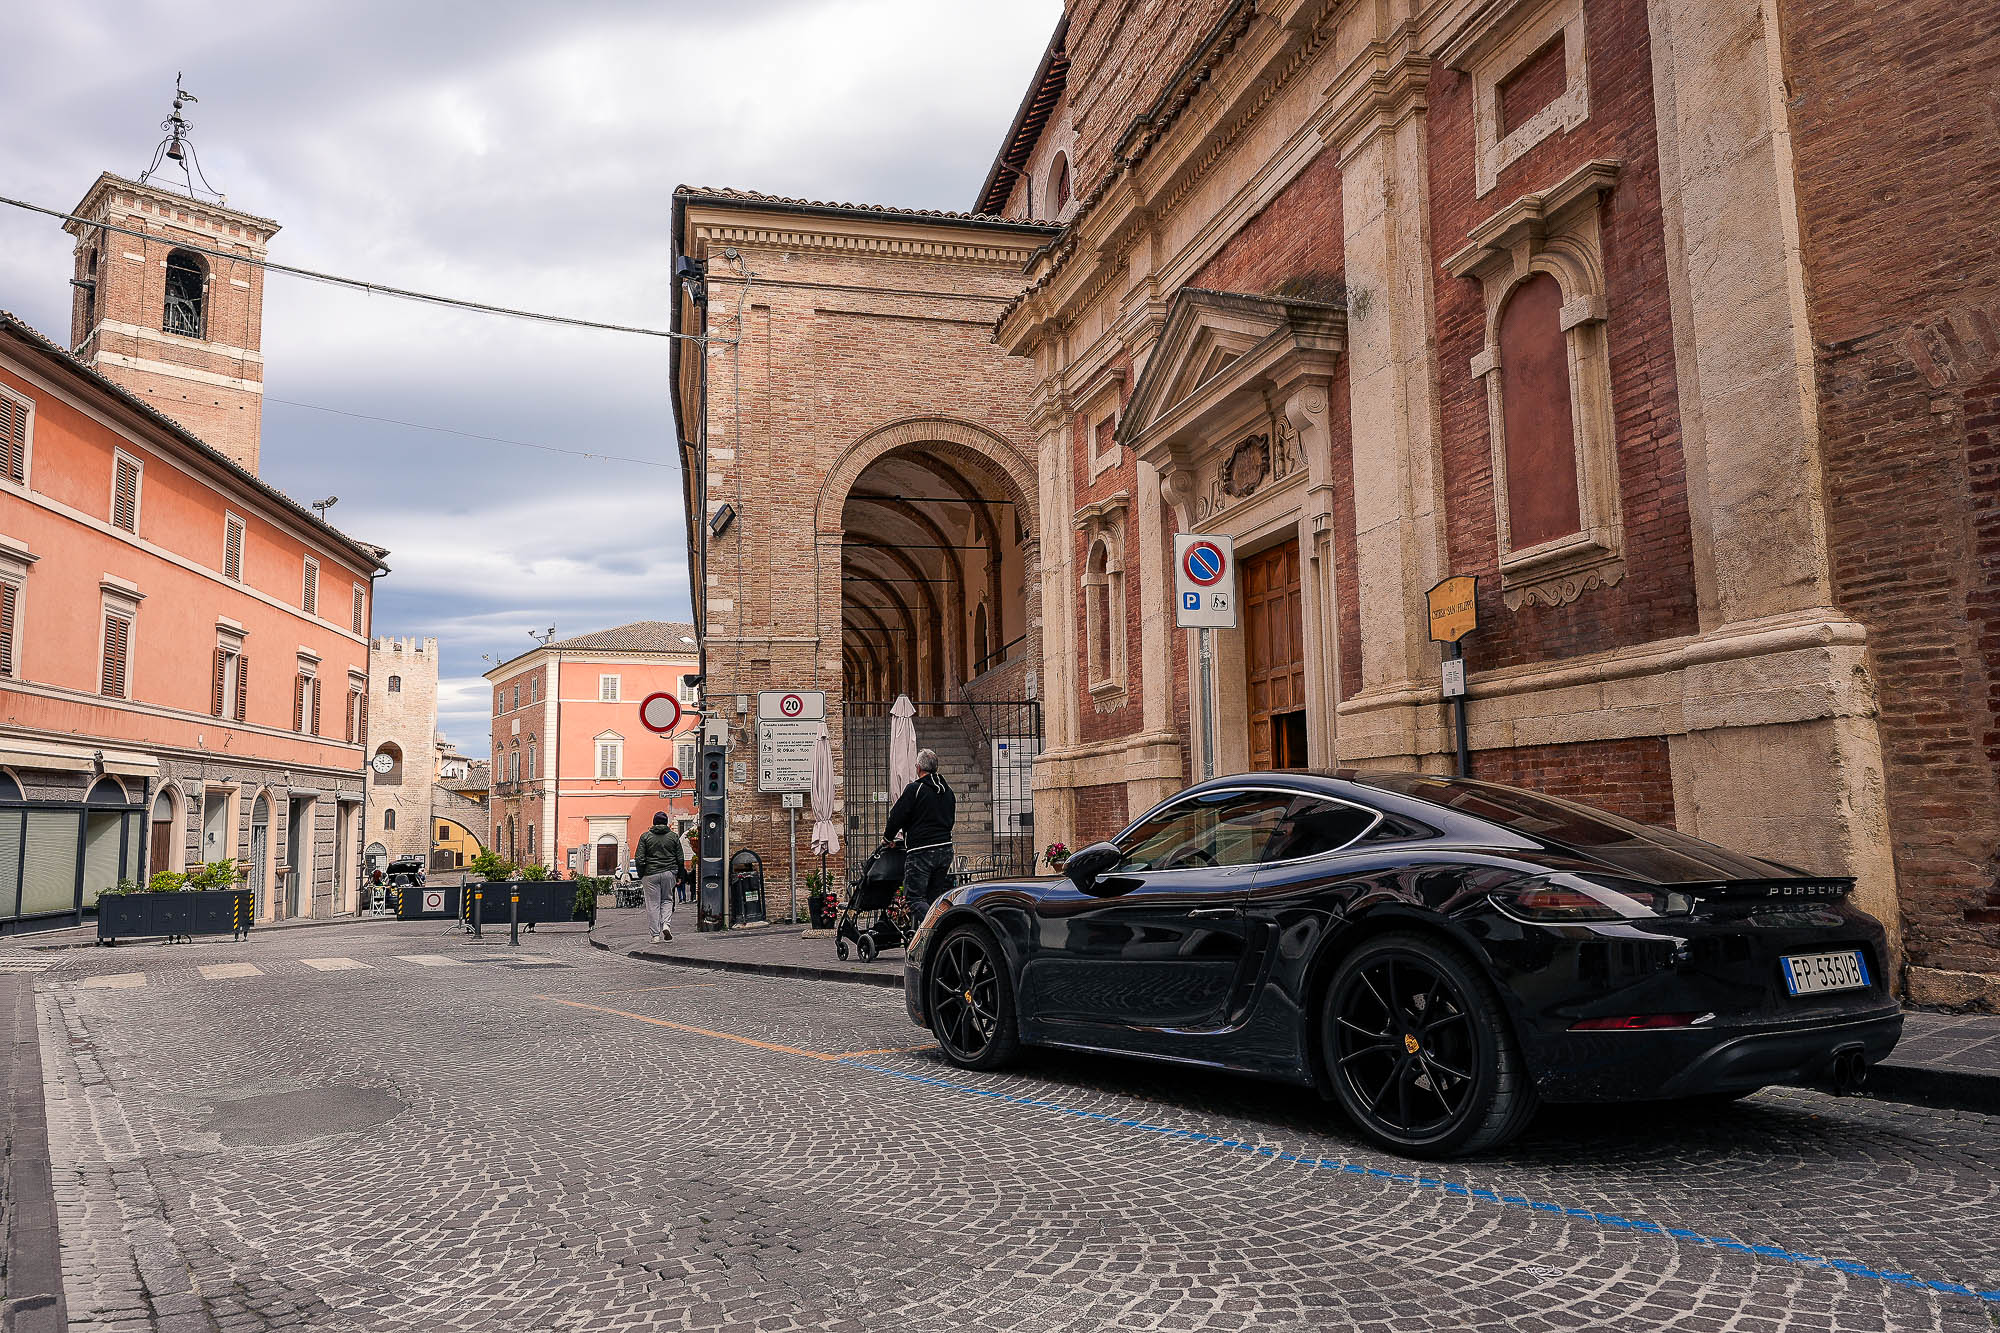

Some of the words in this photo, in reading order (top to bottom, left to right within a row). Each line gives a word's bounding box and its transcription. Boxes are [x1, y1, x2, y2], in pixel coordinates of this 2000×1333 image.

[1186, 594, 1197, 608] P
[1447, 605, 1456, 616] SAN
[1457, 600, 1474, 613] FILIPPO
[785, 700, 799, 711] 20
[764, 770, 771, 779] R
[1768, 886, 1844, 896] PORSCHE
